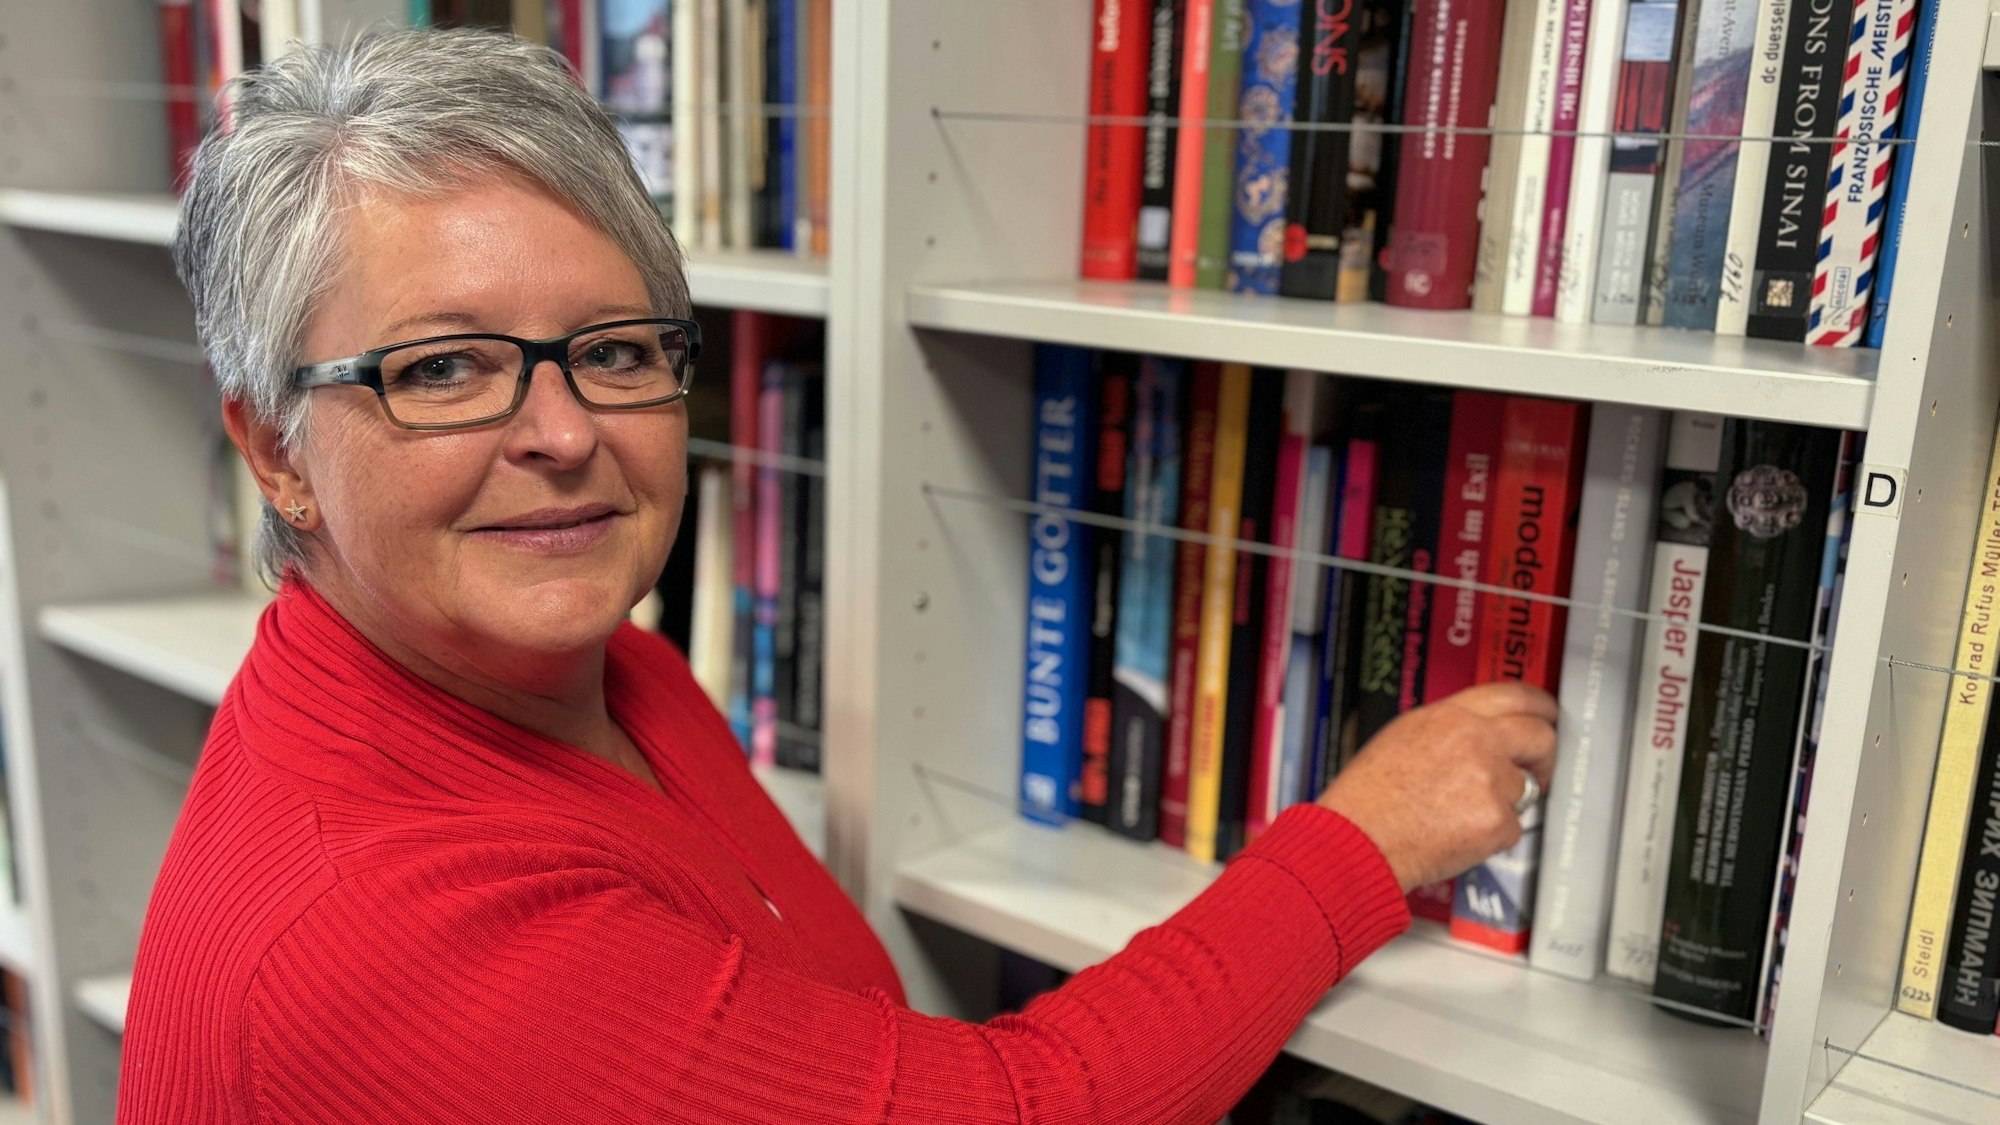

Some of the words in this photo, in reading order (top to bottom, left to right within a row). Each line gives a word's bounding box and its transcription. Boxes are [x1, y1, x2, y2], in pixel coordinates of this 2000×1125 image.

[1433, 34, 1446, 64] DER
[1543, 20, 1554, 65] RECENT
[1764, 0, 1787, 60] duessel
[1804, 0, 1834, 55] ONS
[1760, 67, 1777, 84] dc
[1791, 65, 1823, 157] FROM
[1847, 66, 1884, 203] FRANZÖSISCHE
[1692, 183, 1715, 249] Museum
[1776, 164, 1807, 249] SINAI
[1834, 269, 1850, 305] nicolai
[1033, 395, 1077, 586] GÖTTER
[1465, 452, 1491, 503] Exil
[1863, 472, 1897, 508] D
[1462, 508, 1484, 543] im
[1610, 485, 1631, 539] ISLAND
[1448, 547, 1480, 646] Cranach
[1971, 584, 1995, 636] Rufus
[1984, 519, 2000, 578] Müller
[1661, 560, 1701, 658] Jasper
[1026, 600, 1066, 745] BUNTE
[1581, 631, 1608, 718] COLLECTION
[1652, 658, 1689, 750] Johns
[1570, 734, 1592, 793] MUSEUM
[1736, 716, 1757, 767] PERIOD
[1722, 768, 1749, 859] MEROVINGIAN
[1718, 860, 1735, 888] THE
[1912, 929, 1935, 977] Steidl
[1953, 869, 2000, 1007] ЗИПМАНН
